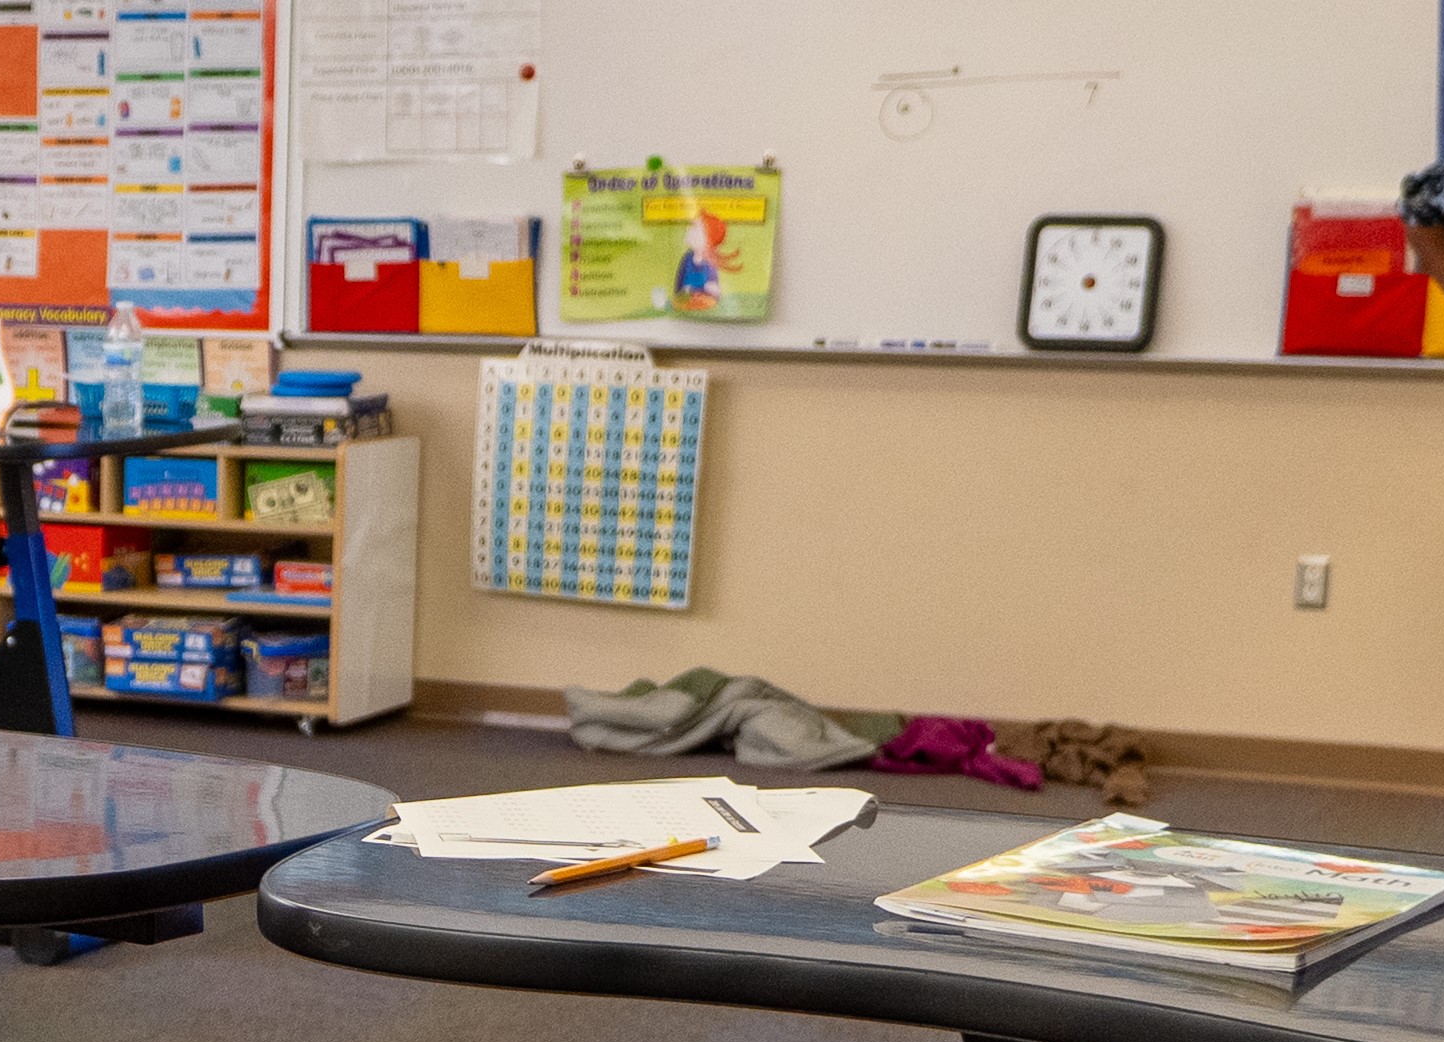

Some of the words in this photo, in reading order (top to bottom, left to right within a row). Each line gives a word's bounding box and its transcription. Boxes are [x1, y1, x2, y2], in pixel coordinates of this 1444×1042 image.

[588, 175, 637, 193] Order
[641, 174, 658, 190] of
[663, 173, 755, 191] Operations
[38, 307, 107, 324] Vocabulary
[528, 343, 646, 361] Multiplication
[1304, 867, 1412, 888] Math
